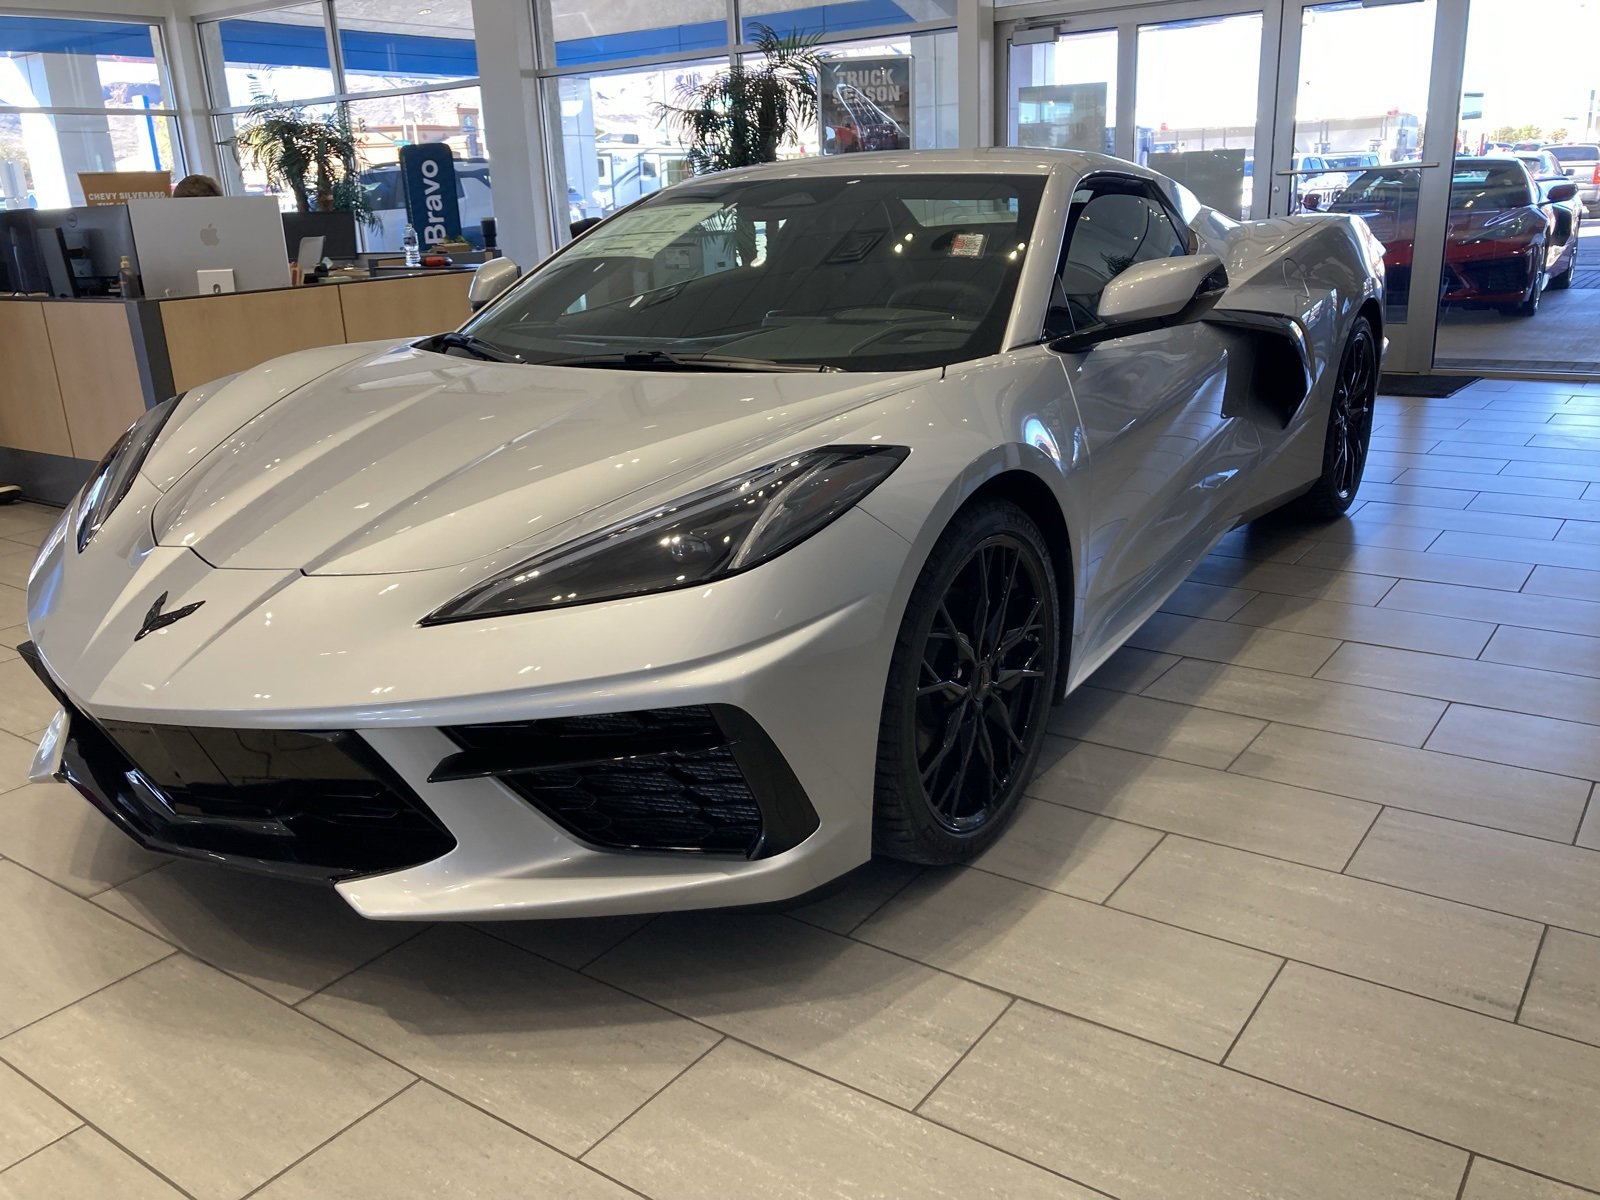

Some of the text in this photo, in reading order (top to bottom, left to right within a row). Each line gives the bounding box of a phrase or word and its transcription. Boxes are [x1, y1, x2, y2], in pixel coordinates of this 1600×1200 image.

[835, 69, 894, 87] TRUCK
[88, 192, 117, 201] CHEVY
[421, 160, 447, 245] Bravo
